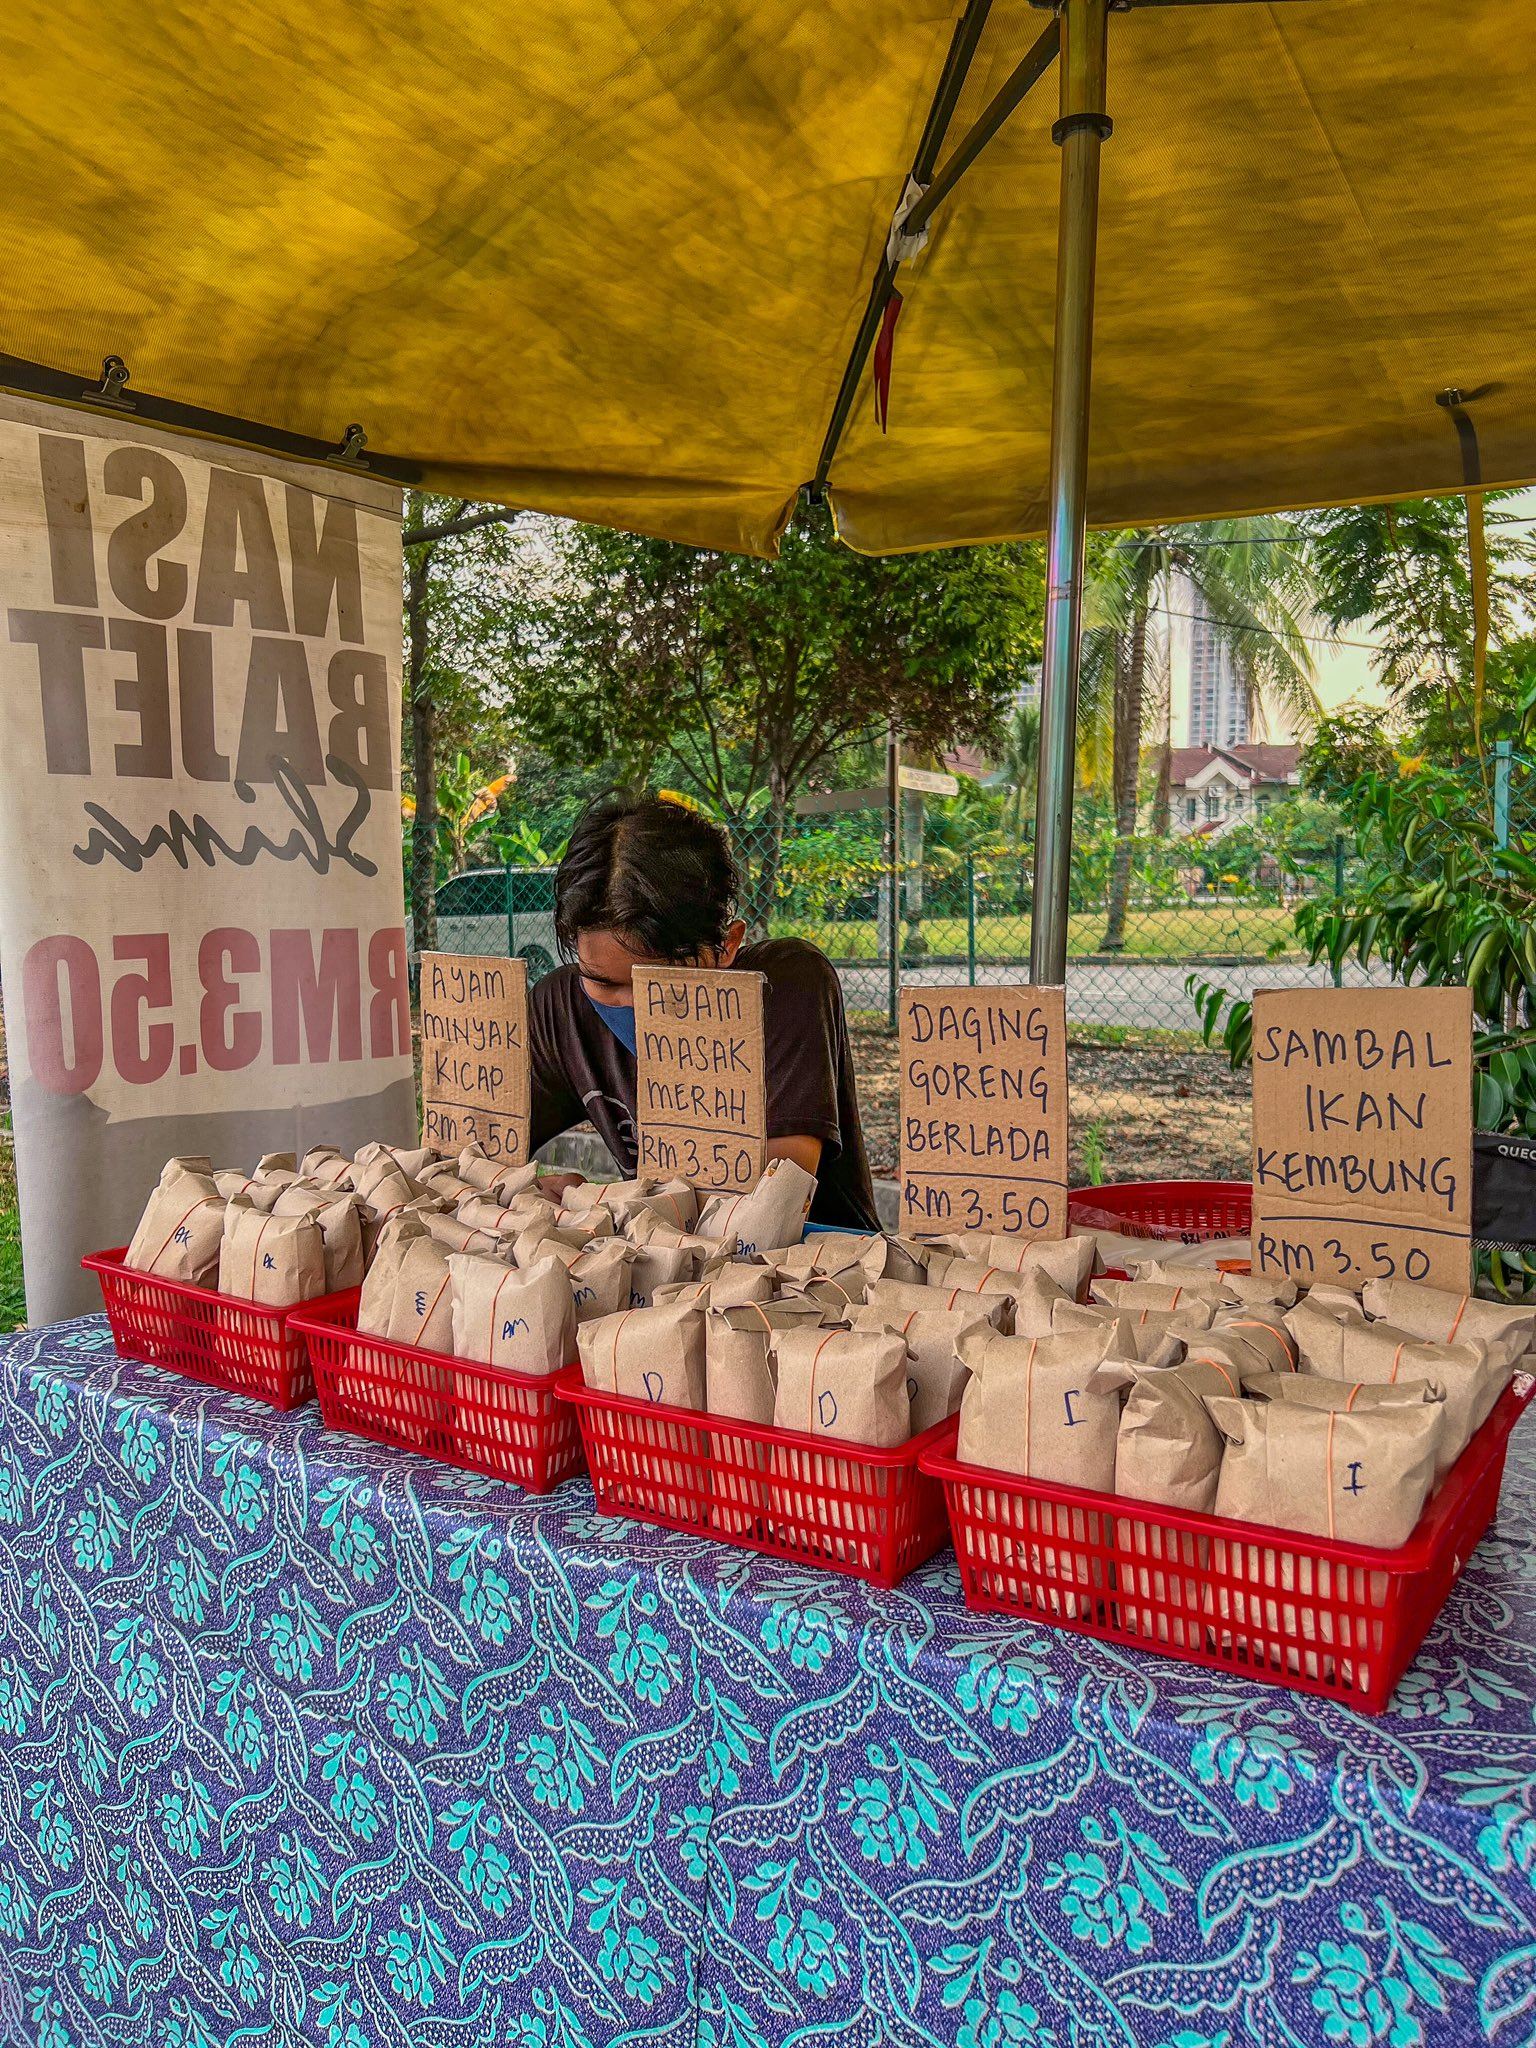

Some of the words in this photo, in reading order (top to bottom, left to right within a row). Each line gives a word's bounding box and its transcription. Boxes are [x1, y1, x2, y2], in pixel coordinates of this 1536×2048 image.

[433, 963, 505, 1003] AYAM
[648, 979, 741, 1022] AYAM
[424, 1009, 521, 1050] MINYAK
[908, 1002, 1048, 1056] DAGING
[1257, 1026, 1452, 1070] SAMBAL
[644, 1032, 751, 1073] MASAK
[435, 1051, 503, 1101] KICAP
[908, 1059, 1048, 1114] GORENG
[647, 1078, 746, 1125] MERAH
[1306, 1084, 1427, 1132] IKAN
[906, 1116, 1050, 1162] BERLADA
[684, 1140, 752, 1187] 3.50
[1256, 1147, 1456, 1212] KEMBUNG
[960, 1188, 1049, 1233] 3.50
[1323, 1239, 1430, 1281] 3.50
[818, 1390, 837, 1427] D
